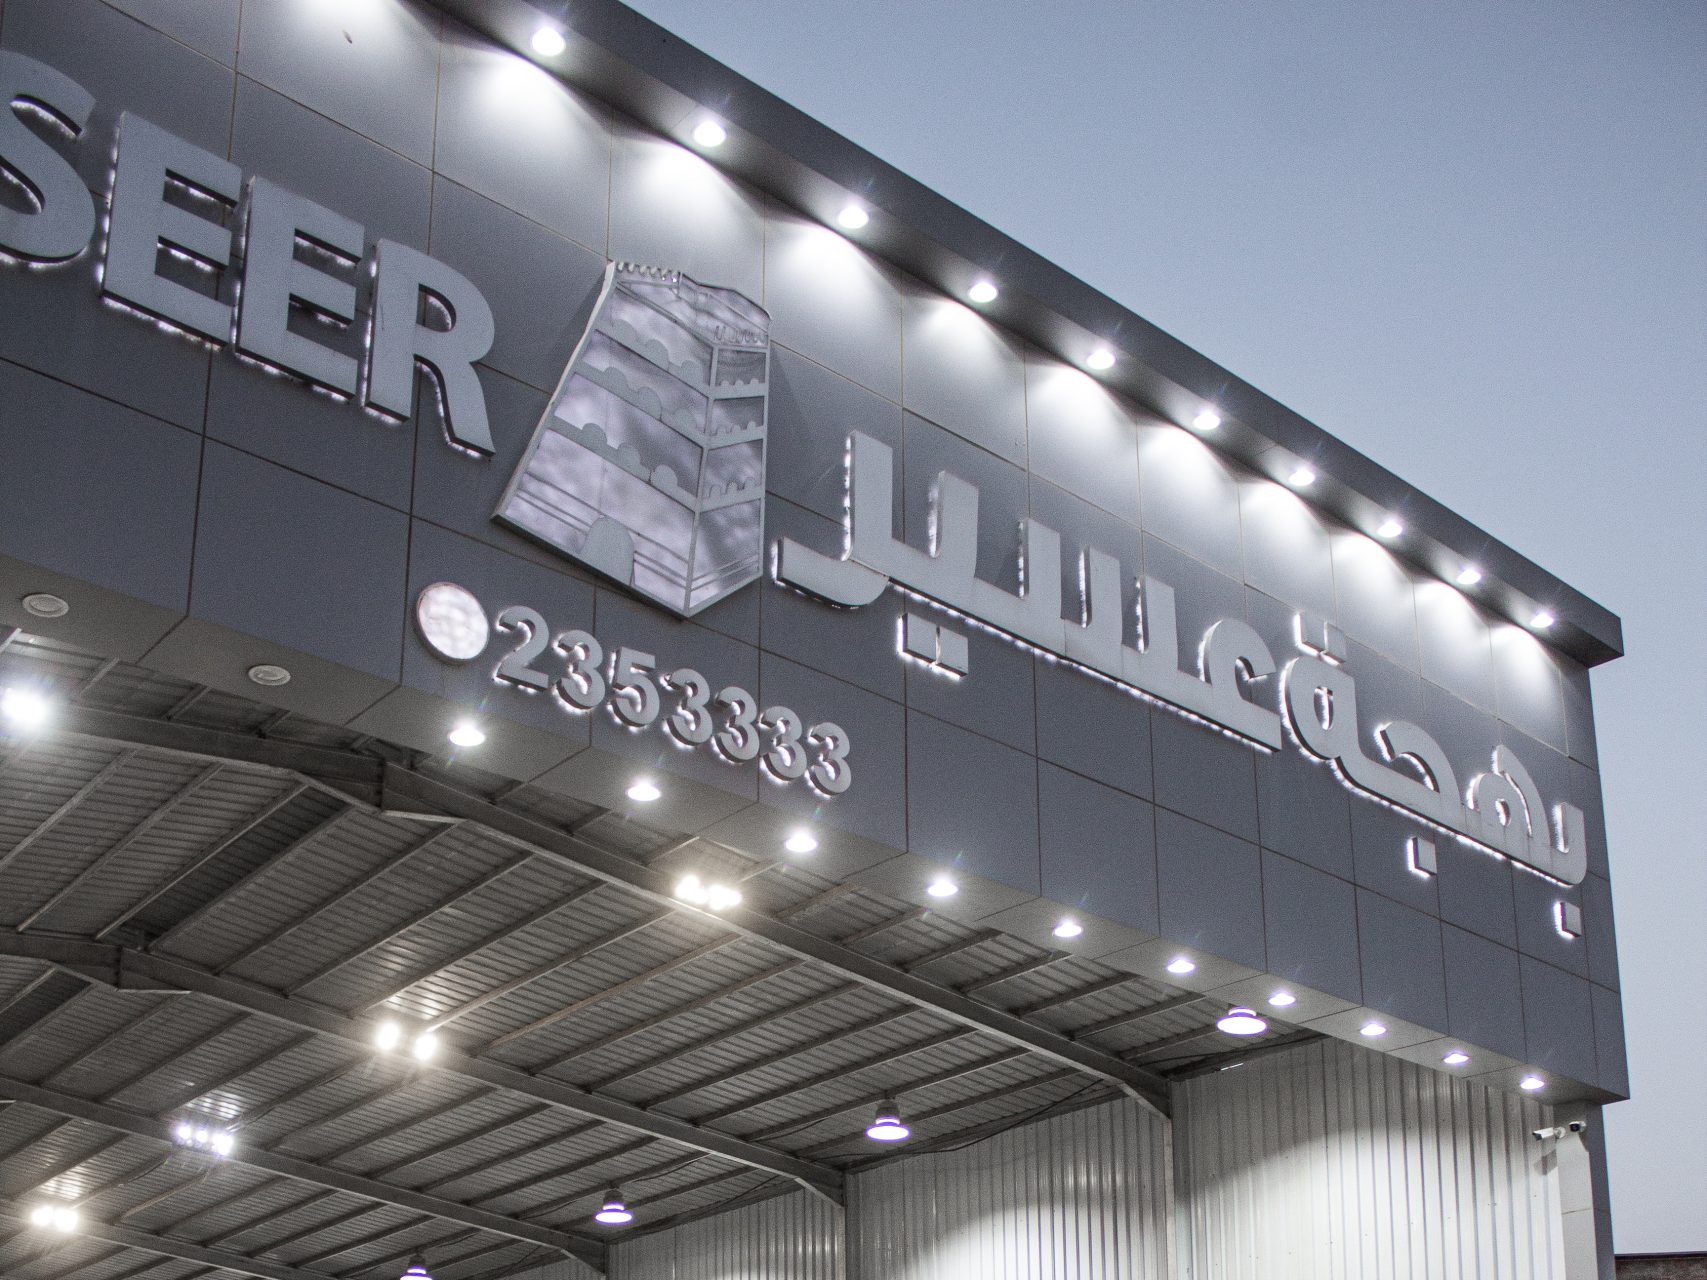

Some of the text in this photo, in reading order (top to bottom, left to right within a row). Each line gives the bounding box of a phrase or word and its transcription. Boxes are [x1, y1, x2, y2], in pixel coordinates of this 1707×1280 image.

[0, 49, 496, 459] SEER
[493, 606, 853, 798] 2353333
[772, 430, 1588, 938] بهجة عسير
